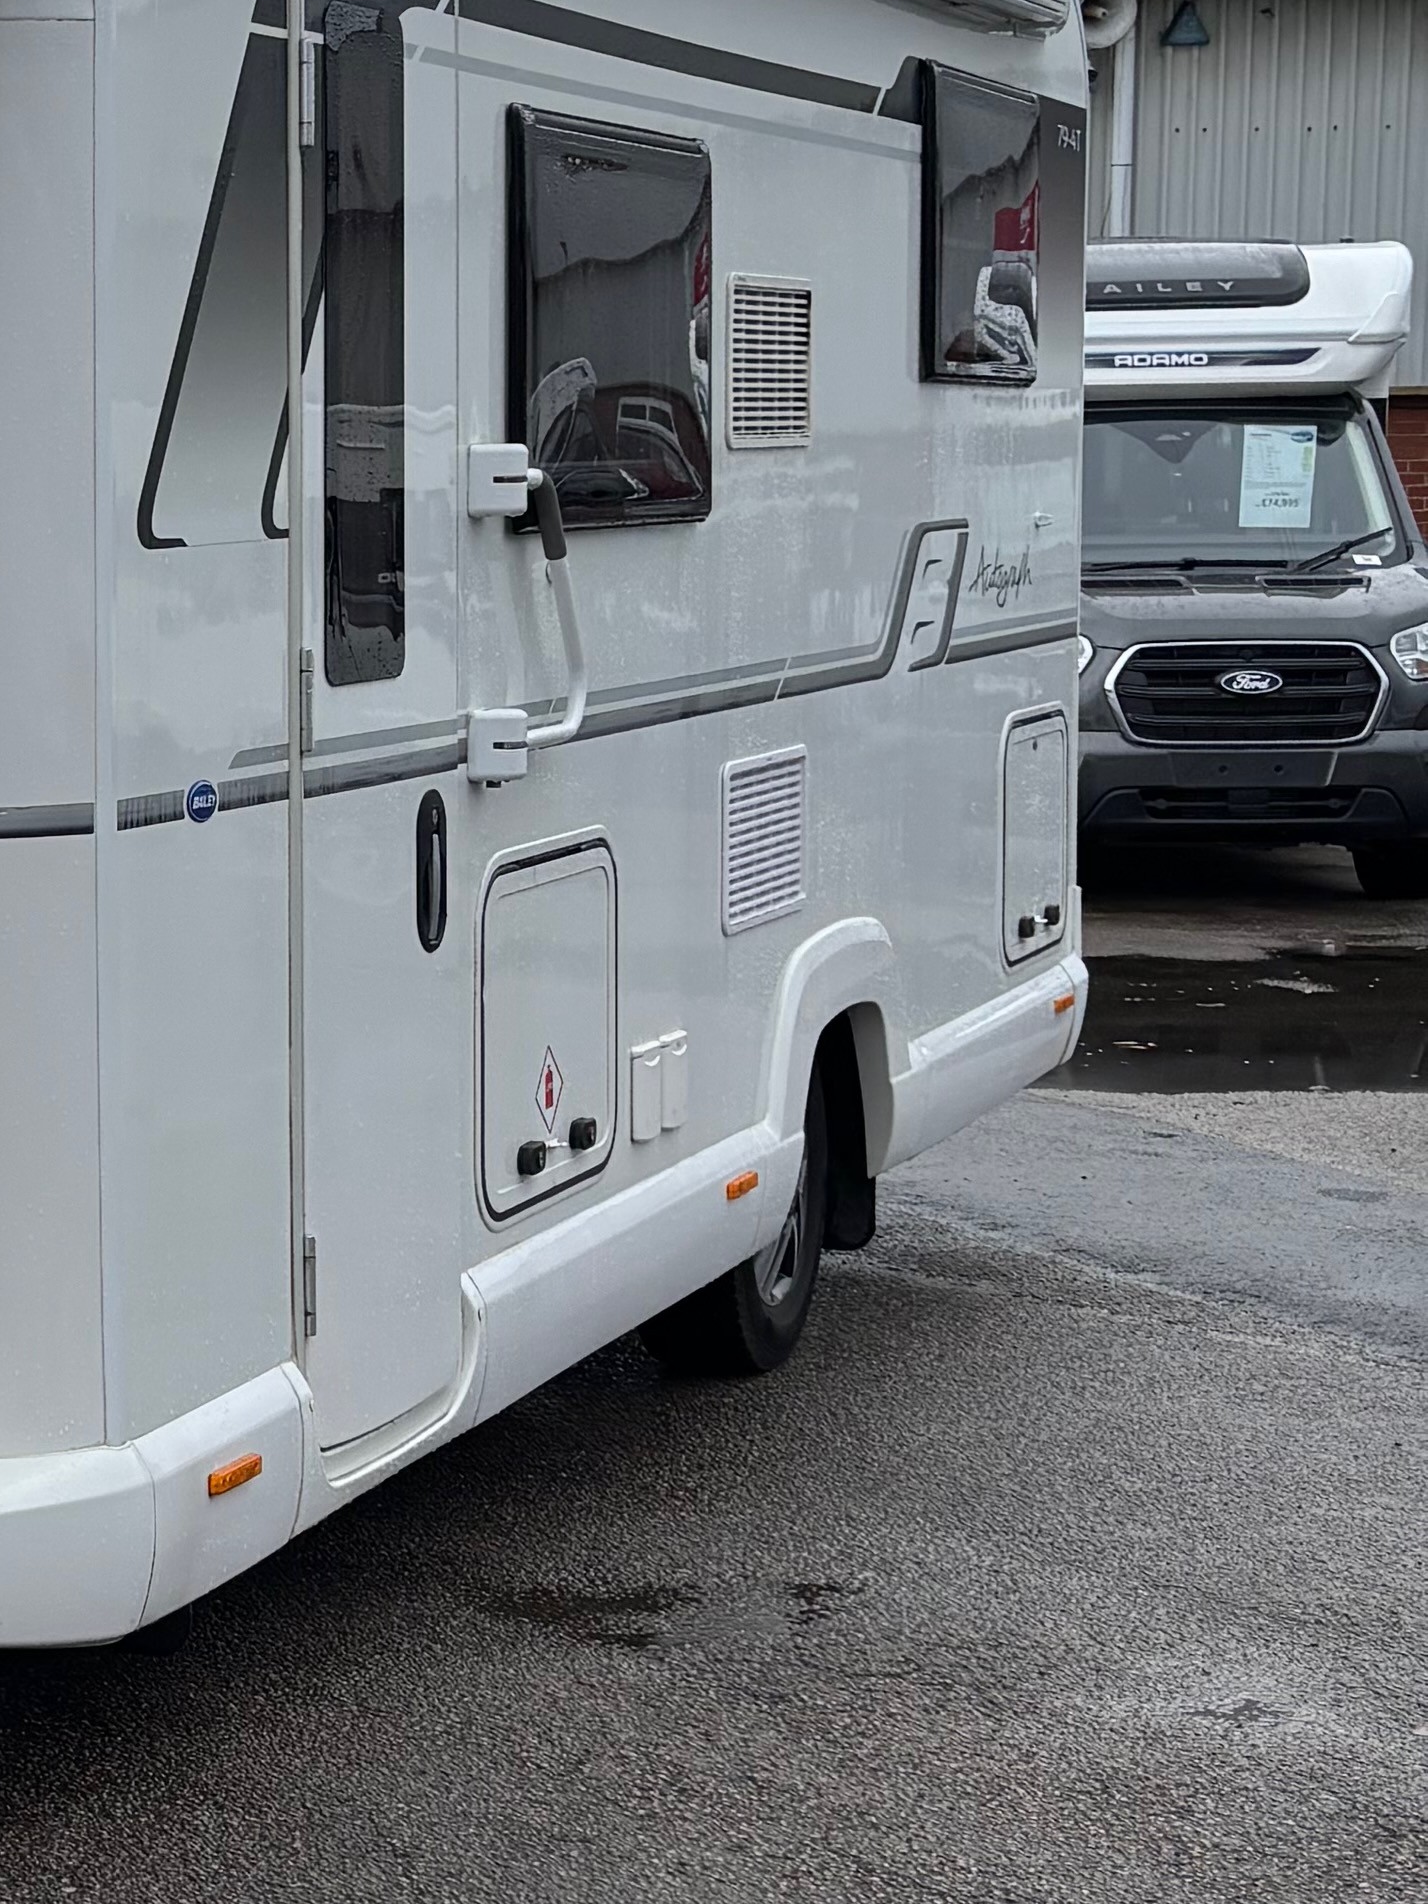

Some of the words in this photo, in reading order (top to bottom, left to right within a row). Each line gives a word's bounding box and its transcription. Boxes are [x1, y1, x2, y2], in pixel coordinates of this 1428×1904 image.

[1103, 280, 1235, 294] AILEY
[1113, 353, 1209, 368] ADAMO
[1232, 674, 1271, 690] Ford
